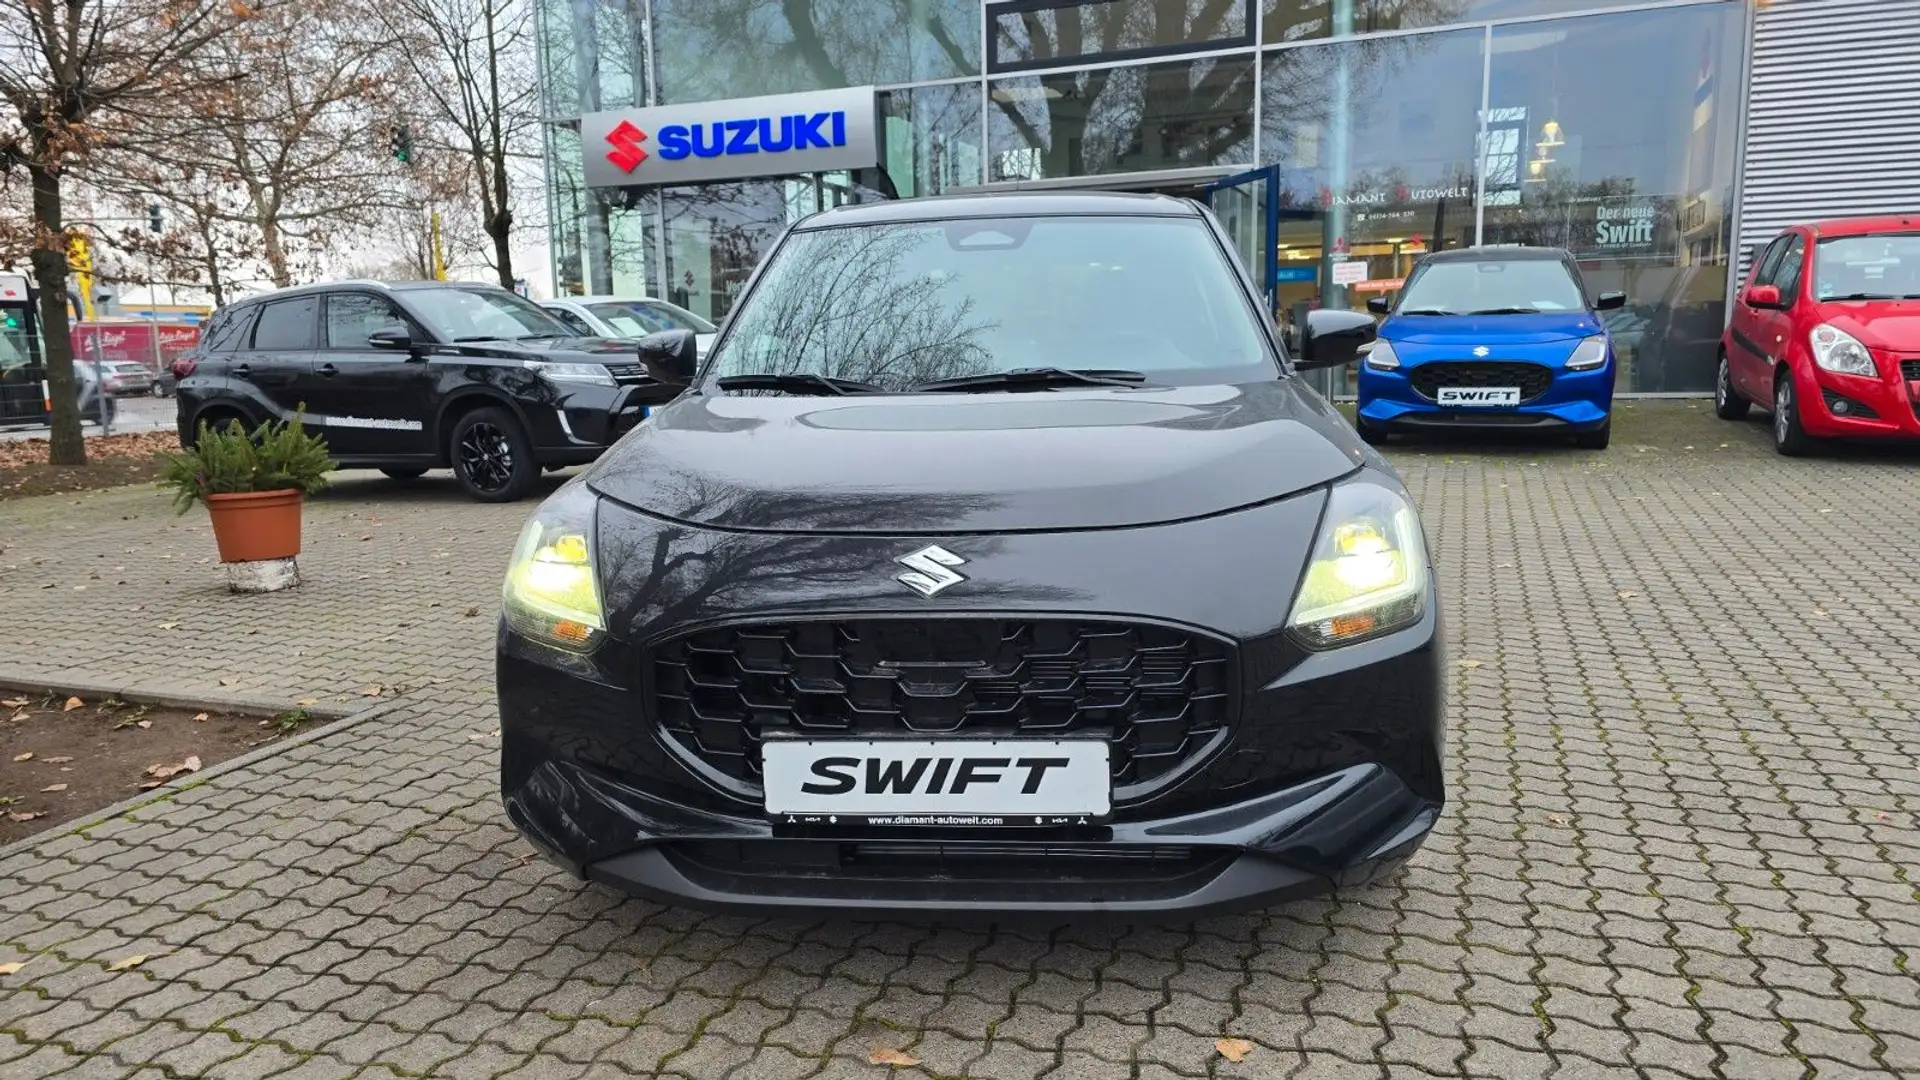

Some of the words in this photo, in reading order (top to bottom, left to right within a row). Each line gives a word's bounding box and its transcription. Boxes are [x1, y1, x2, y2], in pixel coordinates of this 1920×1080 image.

[657, 111, 846, 160] SUZUKI
[1596, 206, 1620, 220] Der
[1622, 206, 1655, 218] neue
[1595, 219, 1653, 244] Swift
[1442, 391, 1517, 401] SWIFT
[800, 757, 1070, 795] SWIFT
[867, 816, 1004, 825] www.diamant-autowelt.com
